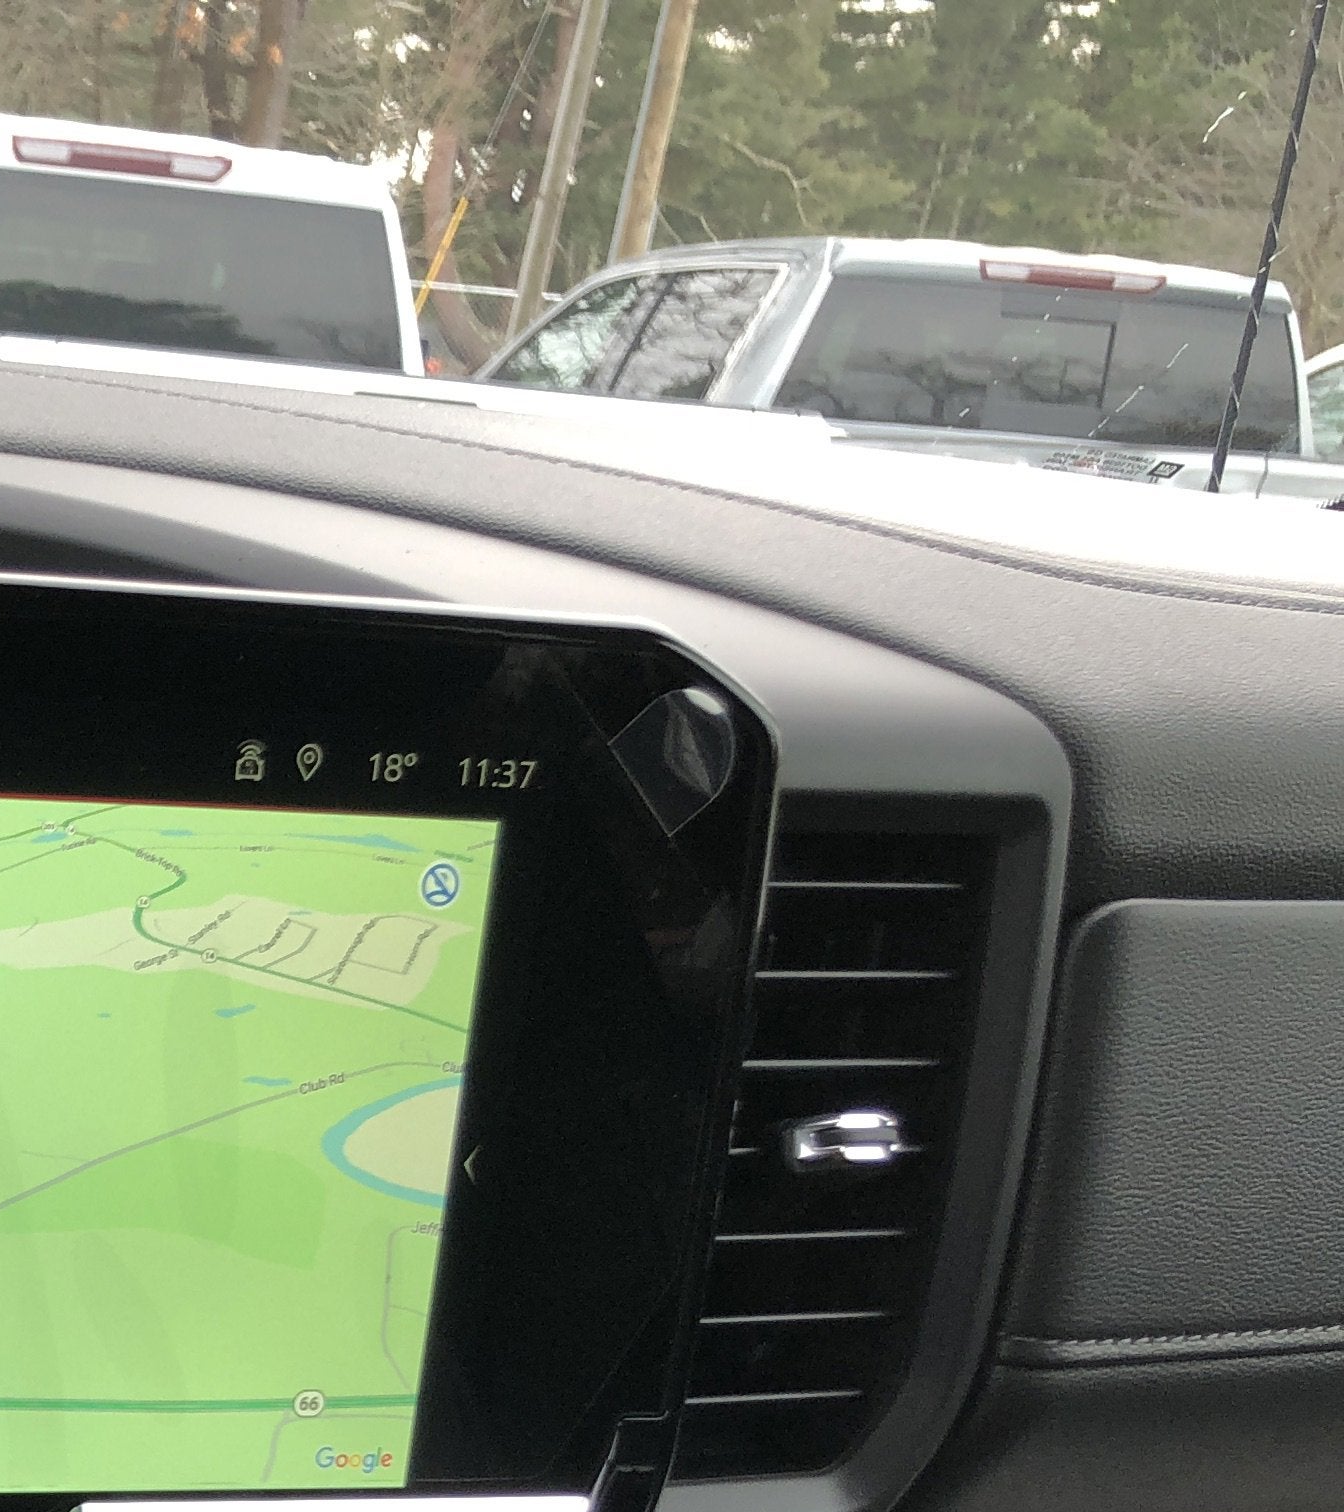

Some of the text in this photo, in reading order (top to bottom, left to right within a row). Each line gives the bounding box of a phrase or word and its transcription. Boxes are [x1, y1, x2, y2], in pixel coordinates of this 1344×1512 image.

[459, 757, 538, 788] 11:37
[157, 857, 173, 871] Top
[134, 954, 168, 971] George
[442, 1061, 463, 1074] Clu
[299, 1072, 345, 1095] Club Rd
[299, 1396, 320, 1411] 66
[315, 1446, 393, 1473] Google
